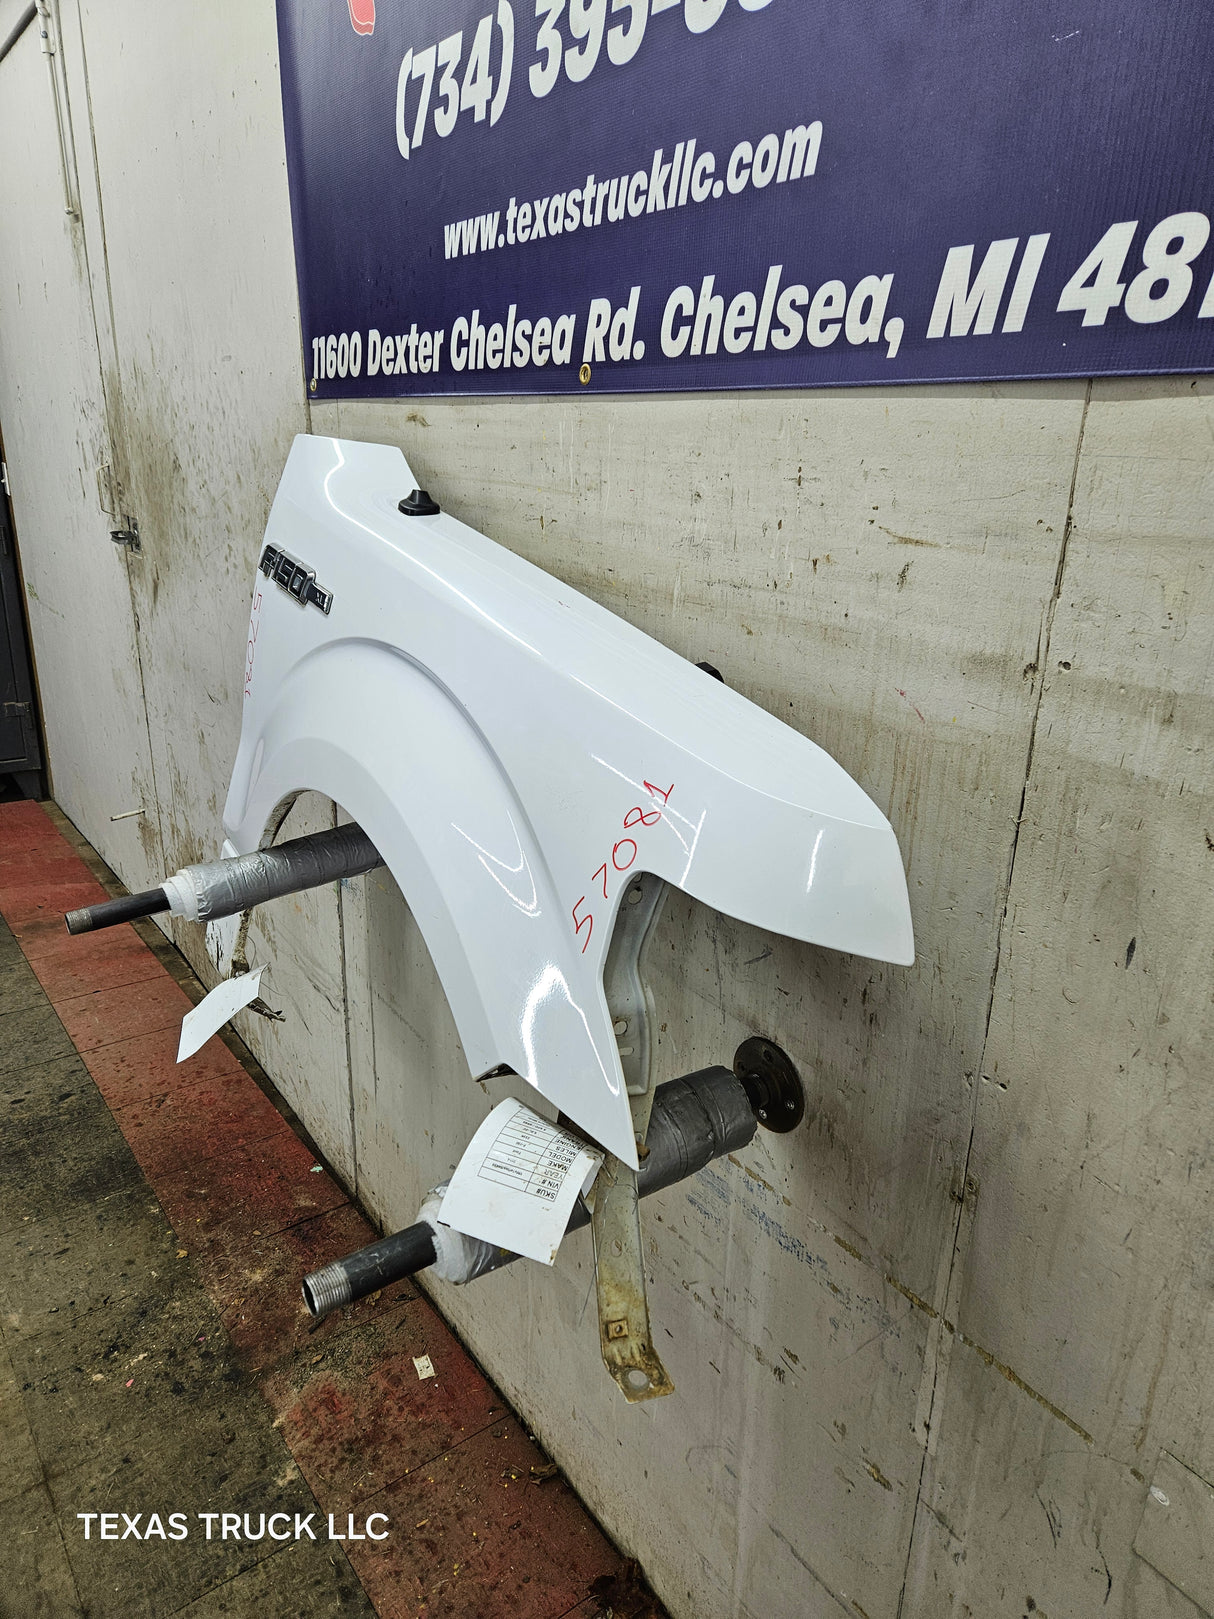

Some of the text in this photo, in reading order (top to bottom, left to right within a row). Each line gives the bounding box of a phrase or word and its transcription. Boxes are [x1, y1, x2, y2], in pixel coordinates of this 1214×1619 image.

[396, 0, 773, 159] (734) 395-
[445, 121, 823, 260] www.texastruckllc.com
[312, 212, 1214, 381] 11600 Dexter Chelsea Rd. Chelsea, MI 48
[572, 780, 675, 954] 57081
[556, 1146, 577, 1157] MILES
[548, 1152, 572, 1163] MODEL
[547, 1161, 568, 1171] MAKE
[544, 1169, 563, 1180] YEAR
[547, 1180, 559, 1189] VIN
[535, 1188, 556, 1200] SKU#
